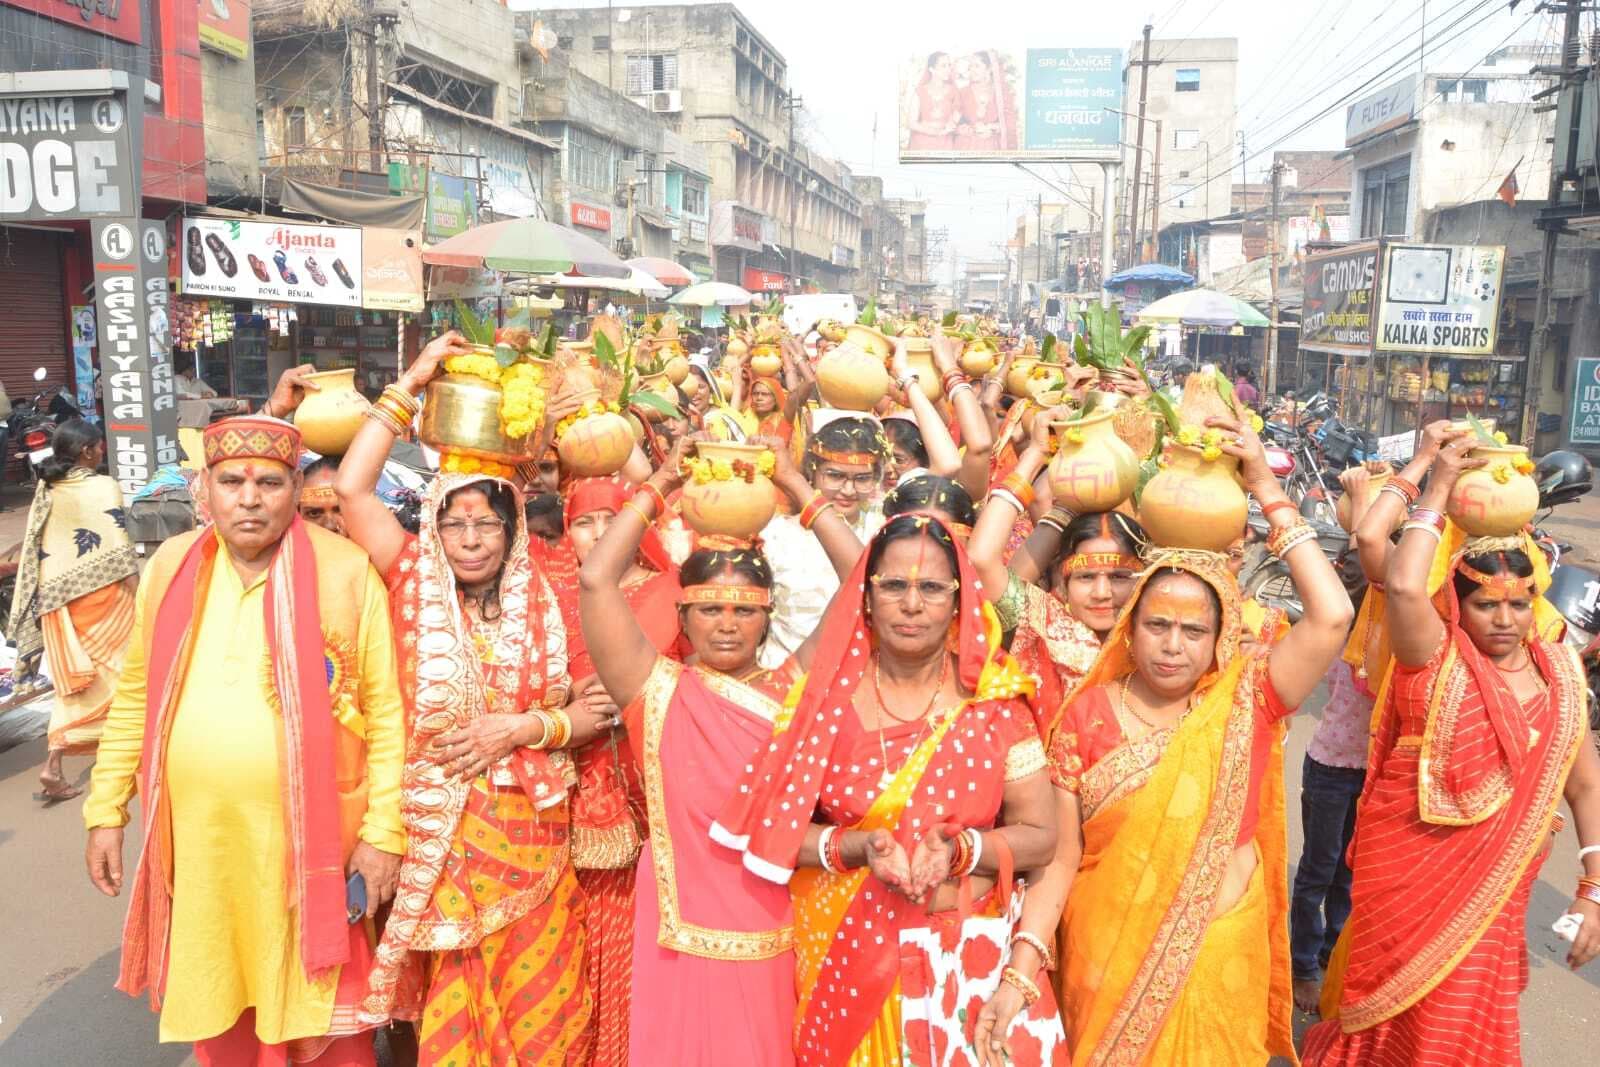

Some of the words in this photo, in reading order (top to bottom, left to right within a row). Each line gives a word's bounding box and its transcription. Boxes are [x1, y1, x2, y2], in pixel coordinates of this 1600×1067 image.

[265, 226, 337, 251] Ajanta
[258, 287, 281, 296] ROYAL
[1383, 323, 1428, 345] KALKA
[1433, 325, 1489, 347] SPORTS
